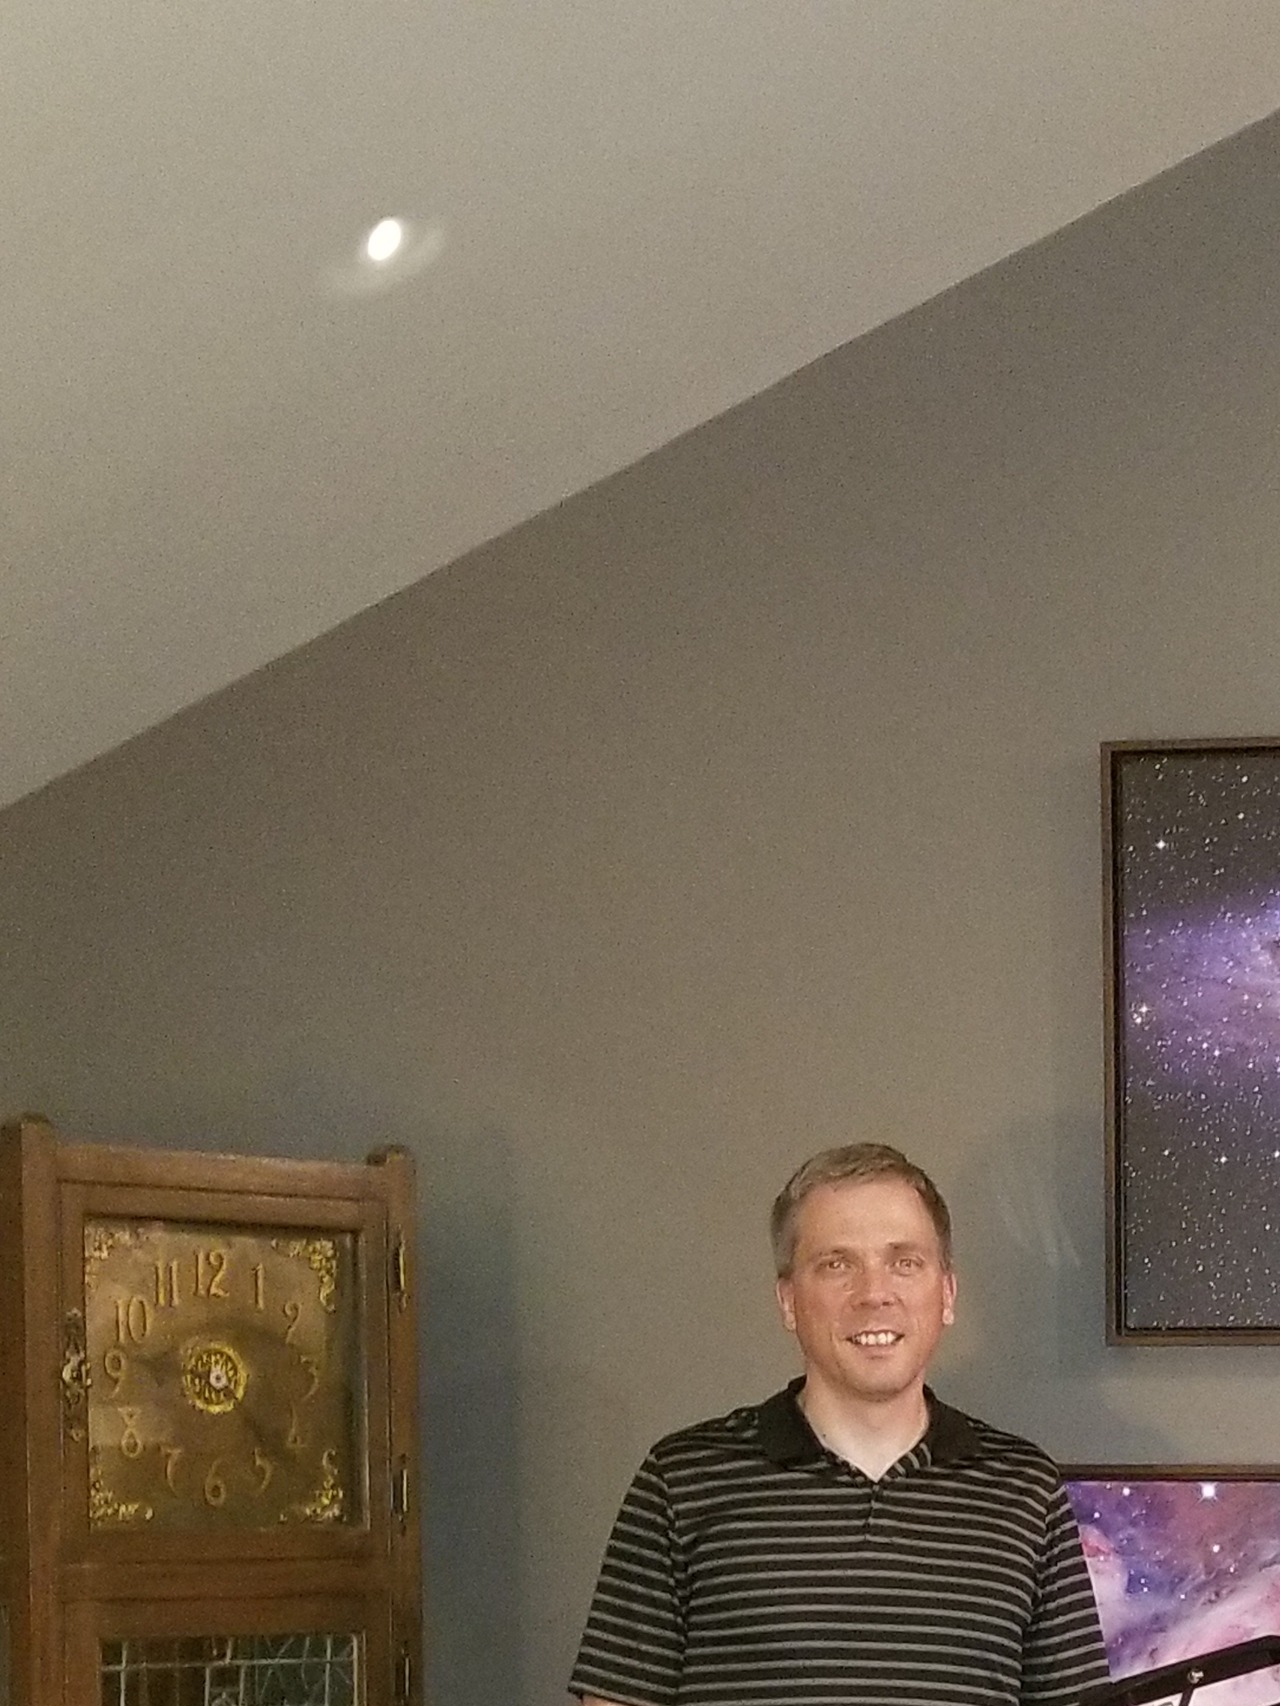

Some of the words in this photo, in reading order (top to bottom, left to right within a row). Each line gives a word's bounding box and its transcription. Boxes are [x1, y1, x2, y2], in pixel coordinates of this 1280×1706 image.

[154, 1256, 179, 1308] 11
[193, 1249, 230, 1298] 12
[251, 1262, 265, 1312] 1
[115, 1296, 150, 1345] 10
[282, 1301, 301, 1345] 2
[104, 1350, 126, 1399] 9
[117, 1406, 142, 1458] 8
[160, 1447, 182, 1498] 7
[204, 1457, 226, 1507] 6
